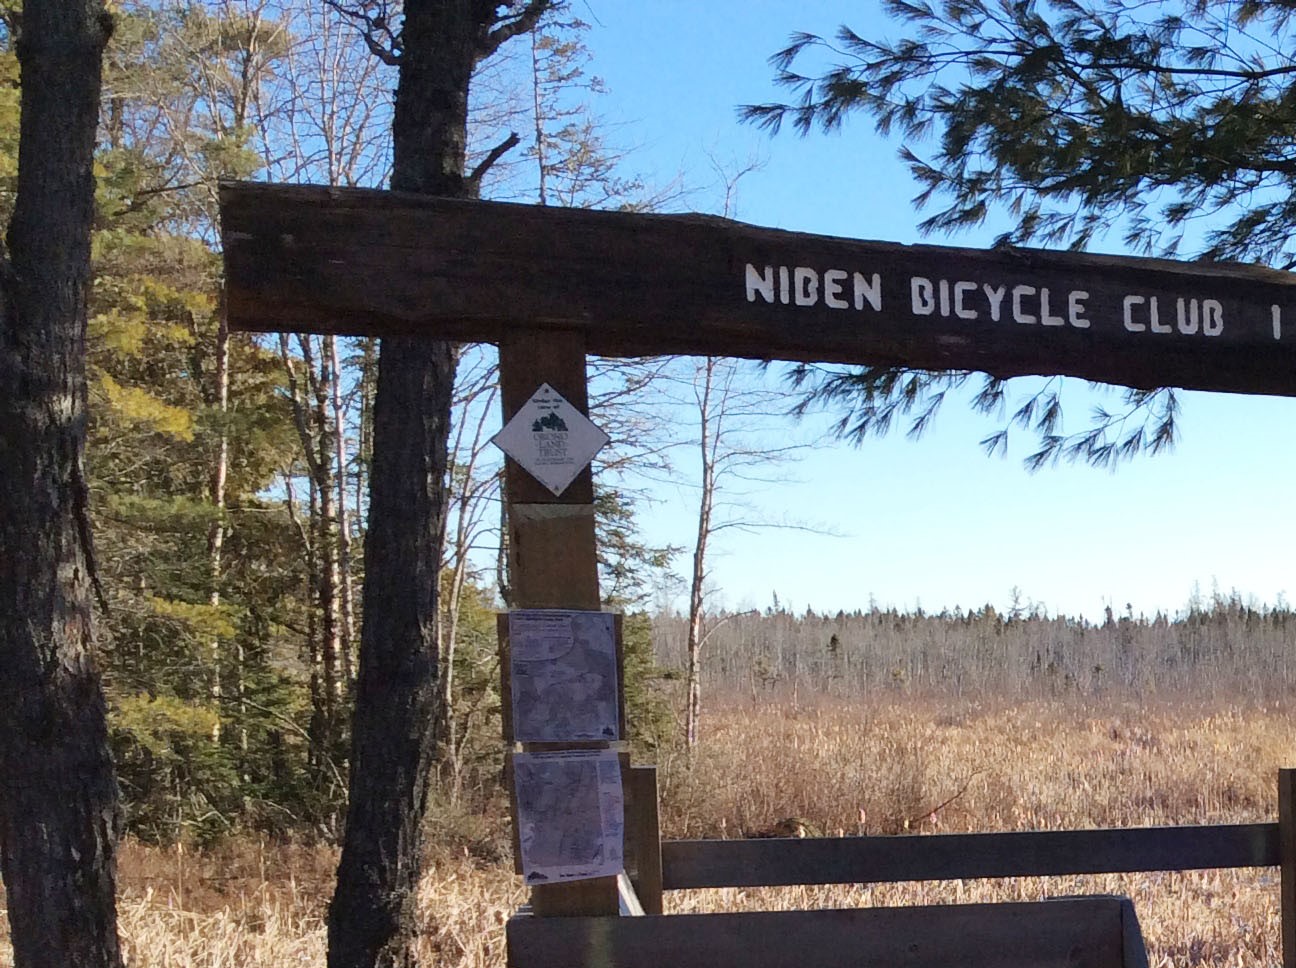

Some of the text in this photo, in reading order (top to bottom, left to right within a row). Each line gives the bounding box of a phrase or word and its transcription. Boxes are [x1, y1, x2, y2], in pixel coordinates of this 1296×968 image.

[745, 263, 882, 312] NIBEN
[910, 276, 1091, 328] BICYCLE
[1123, 295, 1224, 337] CLUB
